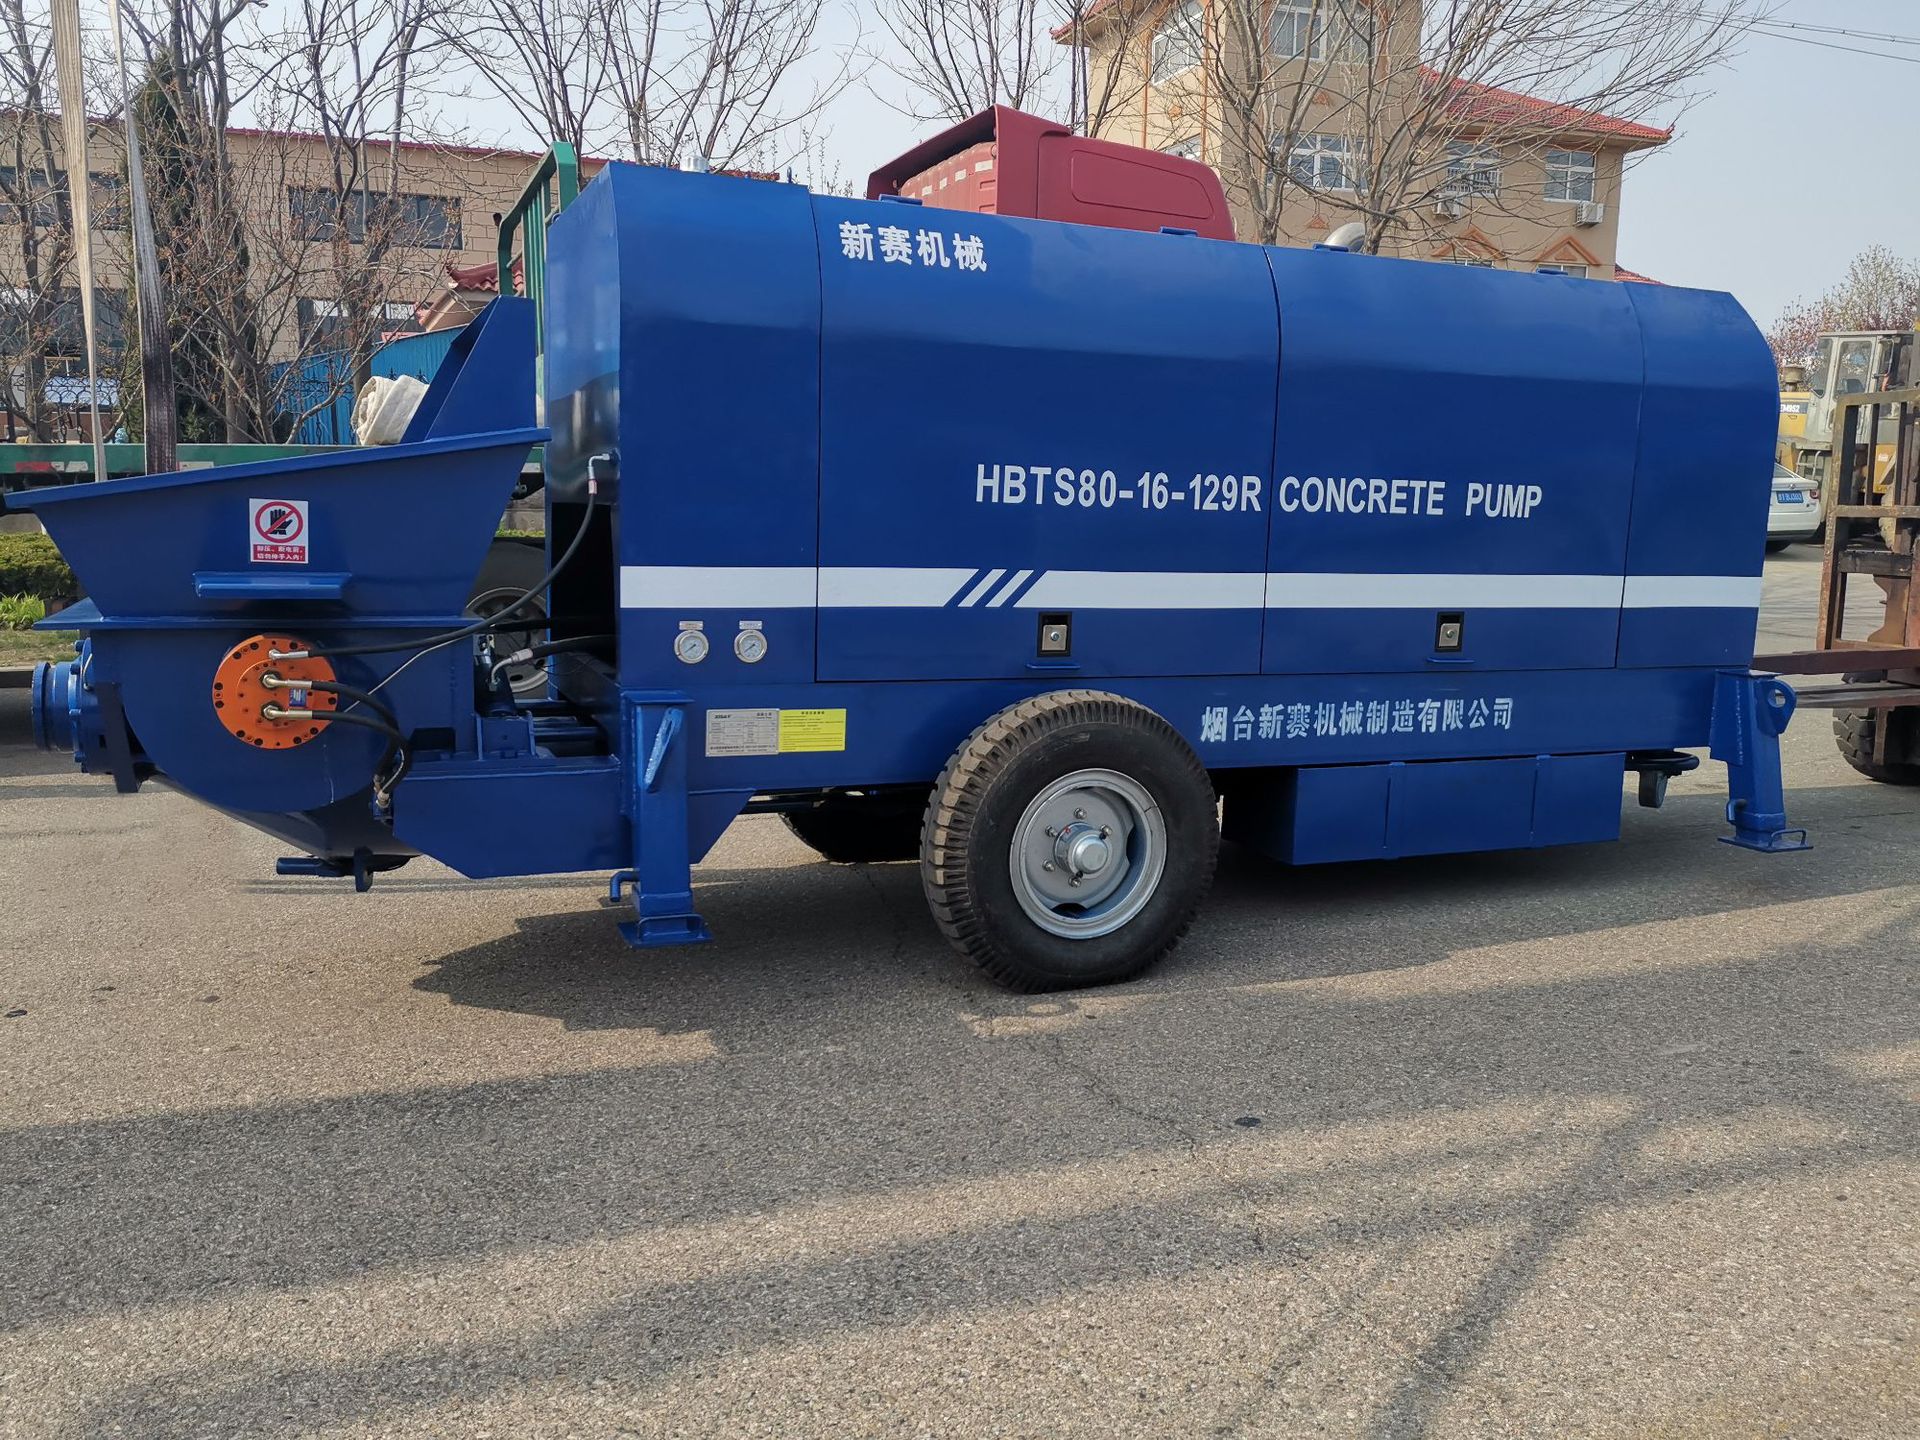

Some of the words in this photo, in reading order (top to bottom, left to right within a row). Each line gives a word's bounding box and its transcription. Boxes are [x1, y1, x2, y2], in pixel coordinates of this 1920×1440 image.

[838, 220, 988, 272] 新赛机械
[975, 463, 1262, 512] HBTS80-16-129R
[1278, 476, 1446, 516] CONCRETE
[1465, 482, 1543, 518] PUMP
[1200, 697, 1513, 743] 烟台新赛机械制造有限公司
